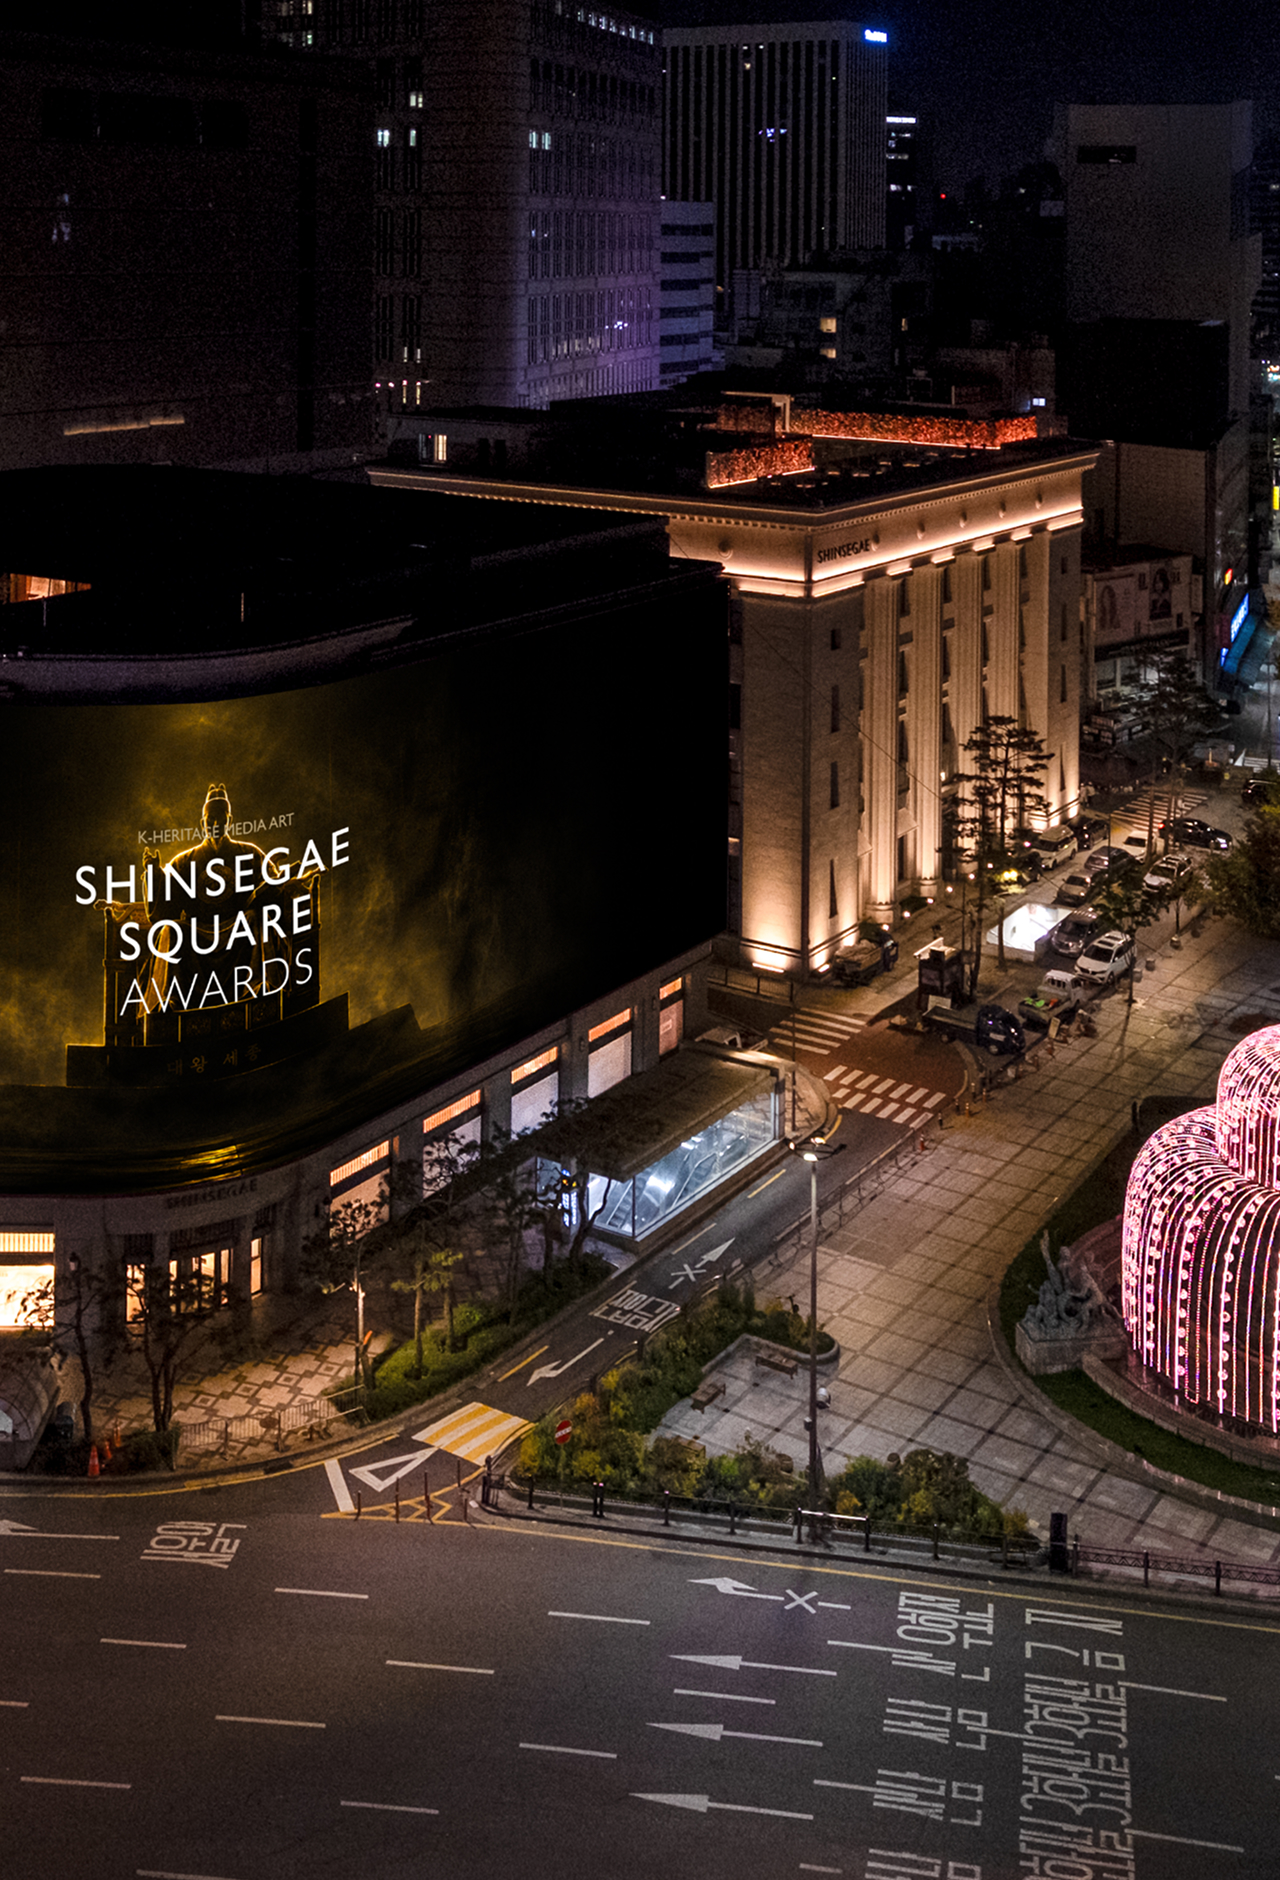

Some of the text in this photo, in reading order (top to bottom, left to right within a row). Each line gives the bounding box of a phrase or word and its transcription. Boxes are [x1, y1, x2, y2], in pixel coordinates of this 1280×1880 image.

[817, 539, 870, 563] SHINSEGAE
[137, 812, 295, 845] K-HERITAGE MEDIA ART
[75, 826, 350, 906] SHINSEGAE
[119, 894, 313, 966] SQUARE
[119, 947, 314, 1017] AWARDS
[140, 1521, 247, 1569] 서울역
[895, 1591, 994, 1649] 우회전
[1024, 1608, 1125, 1671] 금지
[1023, 1672, 1128, 1749] 3호터널
[1020, 1741, 1132, 1826] 3호터널
[1019, 1815, 1135, 1880] 호터널
